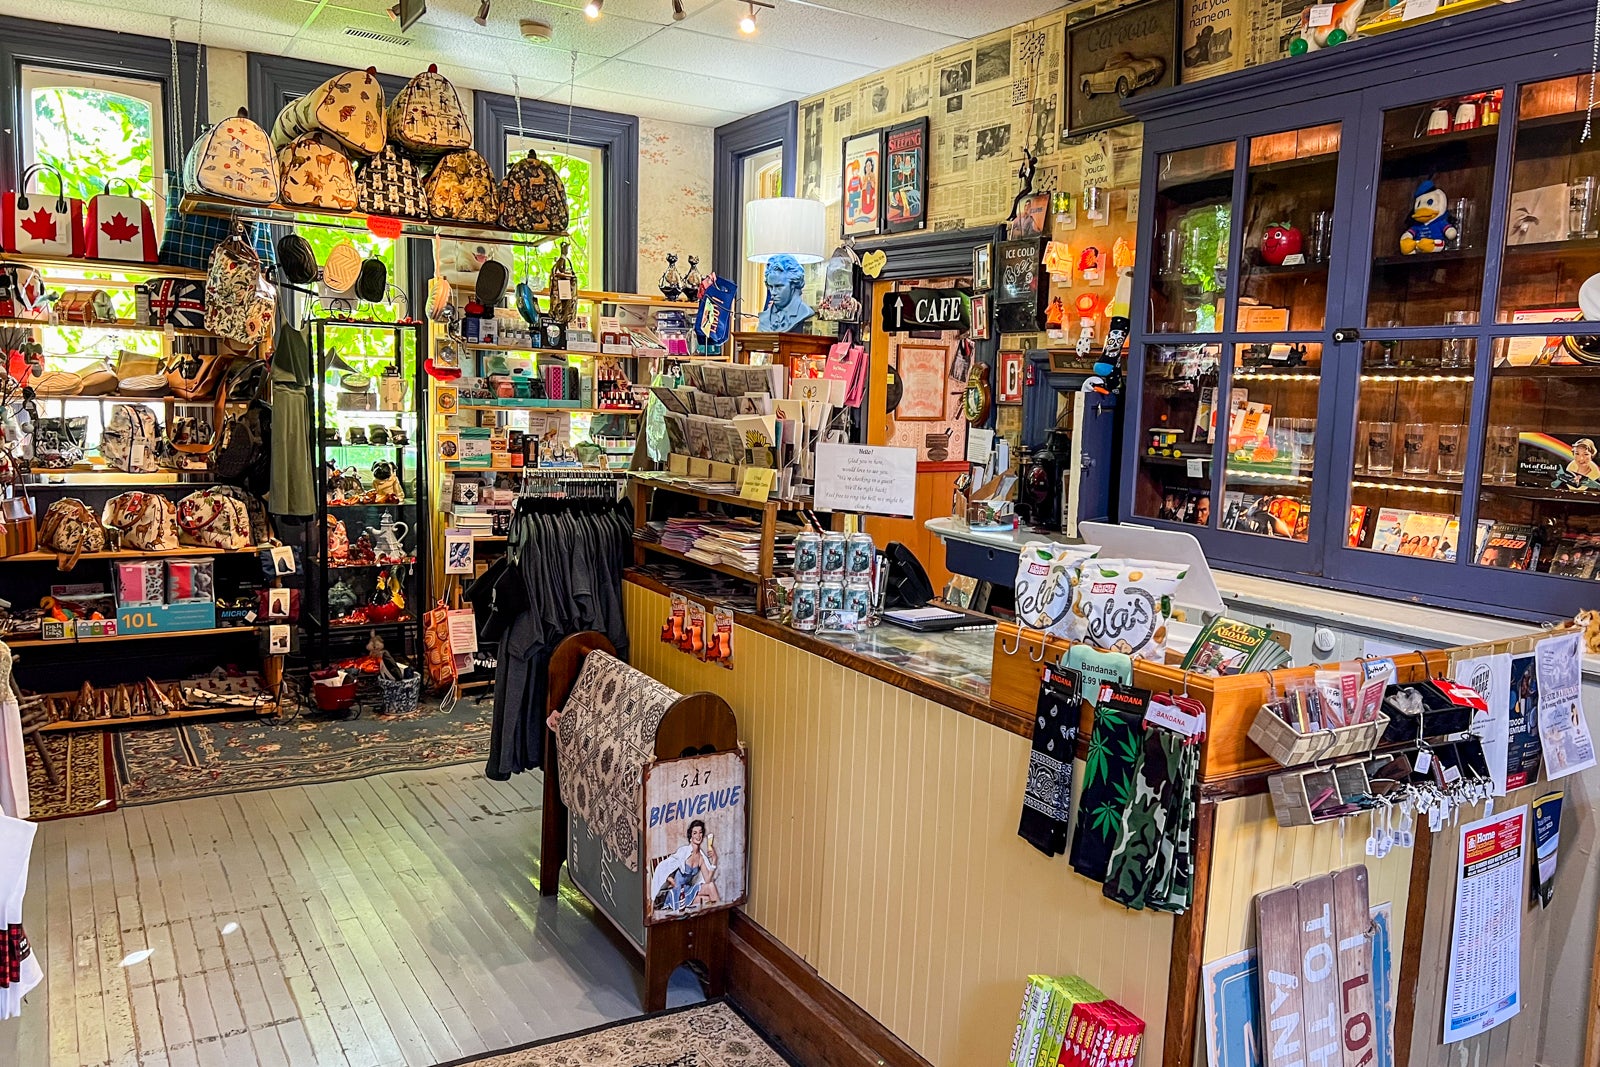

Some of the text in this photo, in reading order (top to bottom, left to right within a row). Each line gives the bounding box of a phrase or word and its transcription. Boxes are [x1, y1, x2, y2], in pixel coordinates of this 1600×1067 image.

[1191, 2, 1208, 17] put
[1189, 12, 1217, 29] name
[889, 133, 921, 151] SLEEPING
[1084, 153, 1103, 164] Quality
[1005, 247, 1035, 259] ICE COLD
[915, 297, 961, 323] CAFE
[1488, 538, 1527, 549] SPEED
[1230, 624, 1249, 635] ALL
[1081, 662, 1118, 677] Bandanas
[1050, 675, 1072, 688] ANDANA
[1156, 710, 1186, 727] BANDANA
[680, 769, 712, 788] 5 À 7
[649, 785, 742, 828] BIENVENUE
[1476, 831, 1496, 844] Home
[1303, 903, 1334, 983] TO
[1339, 932, 1369, 952] I
[1036, 991, 1050, 1030] STIK
[1268, 969, 1304, 1067] AN
[1009, 981, 1032, 1063] GUM STIK
